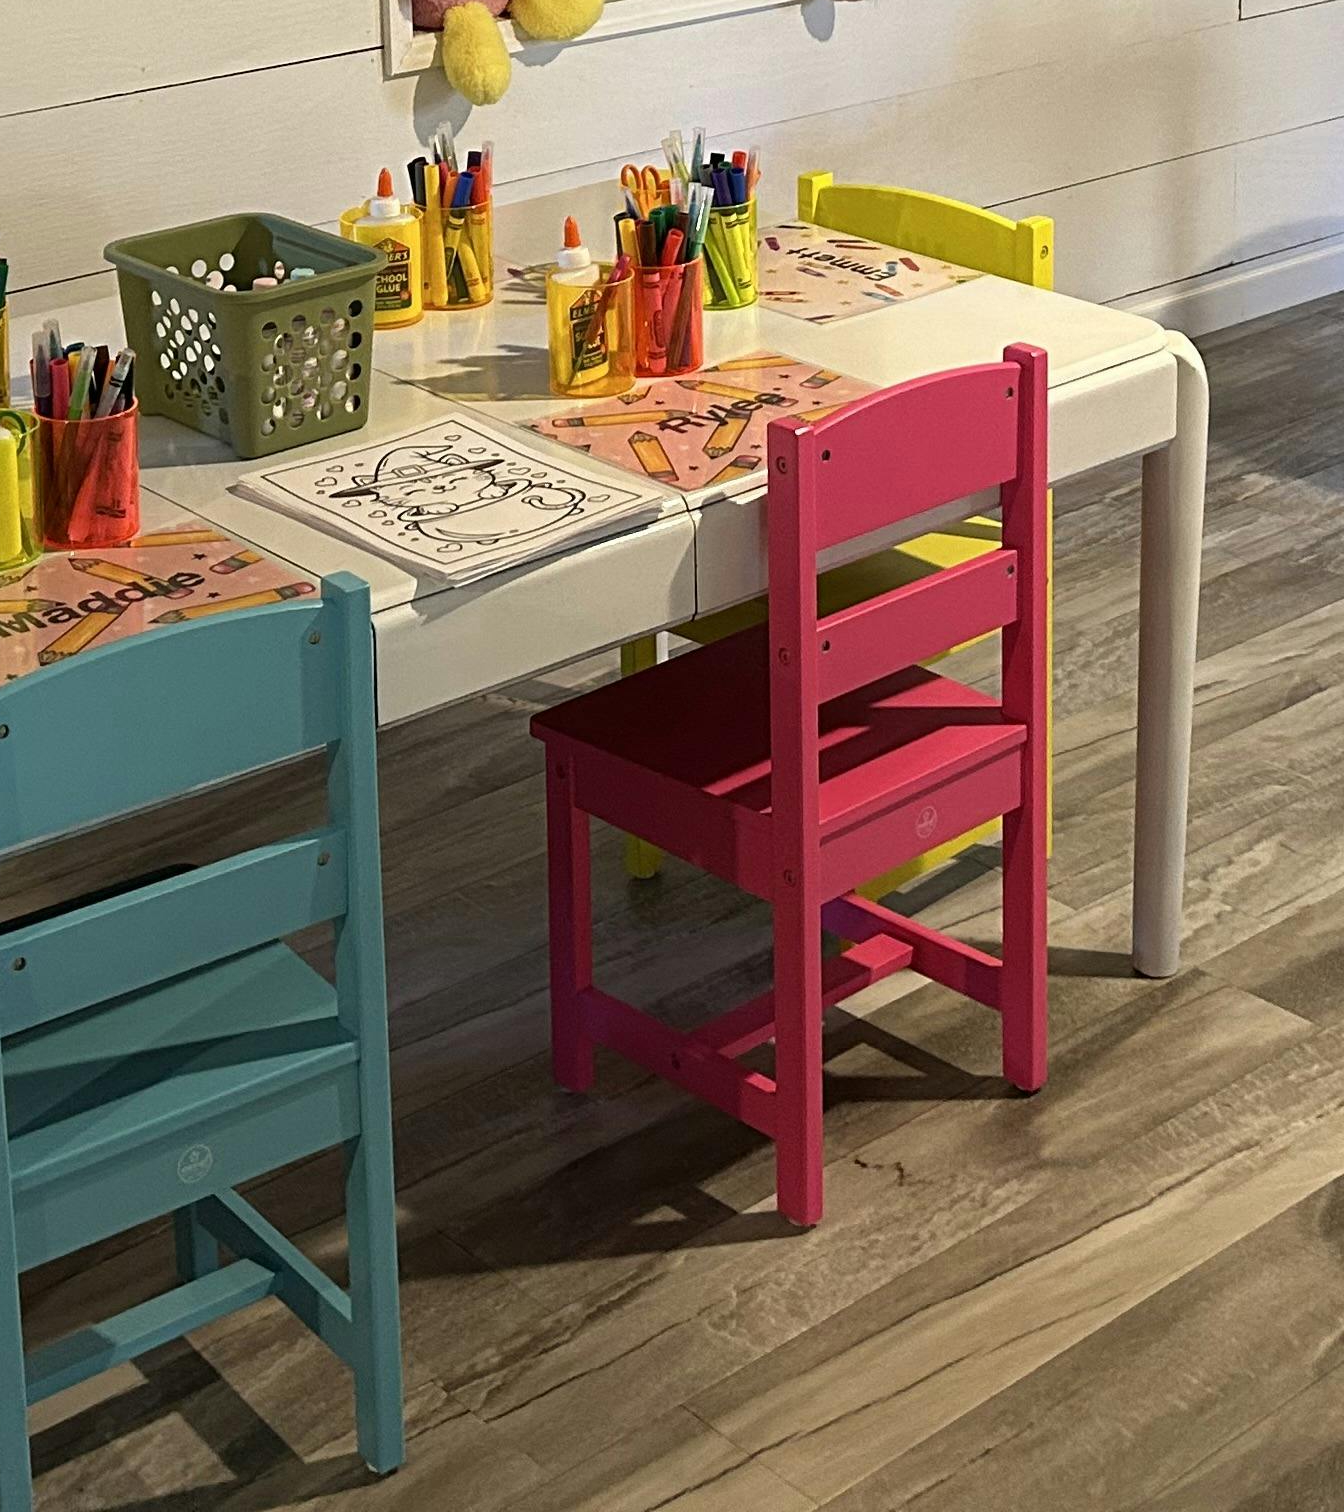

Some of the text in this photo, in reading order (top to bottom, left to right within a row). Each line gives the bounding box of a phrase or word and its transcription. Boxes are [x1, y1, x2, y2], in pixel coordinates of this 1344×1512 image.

[786, 248, 897, 281] Emmett
[376, 284, 401, 292] GLUE
[657, 393, 785, 433] Rylee
